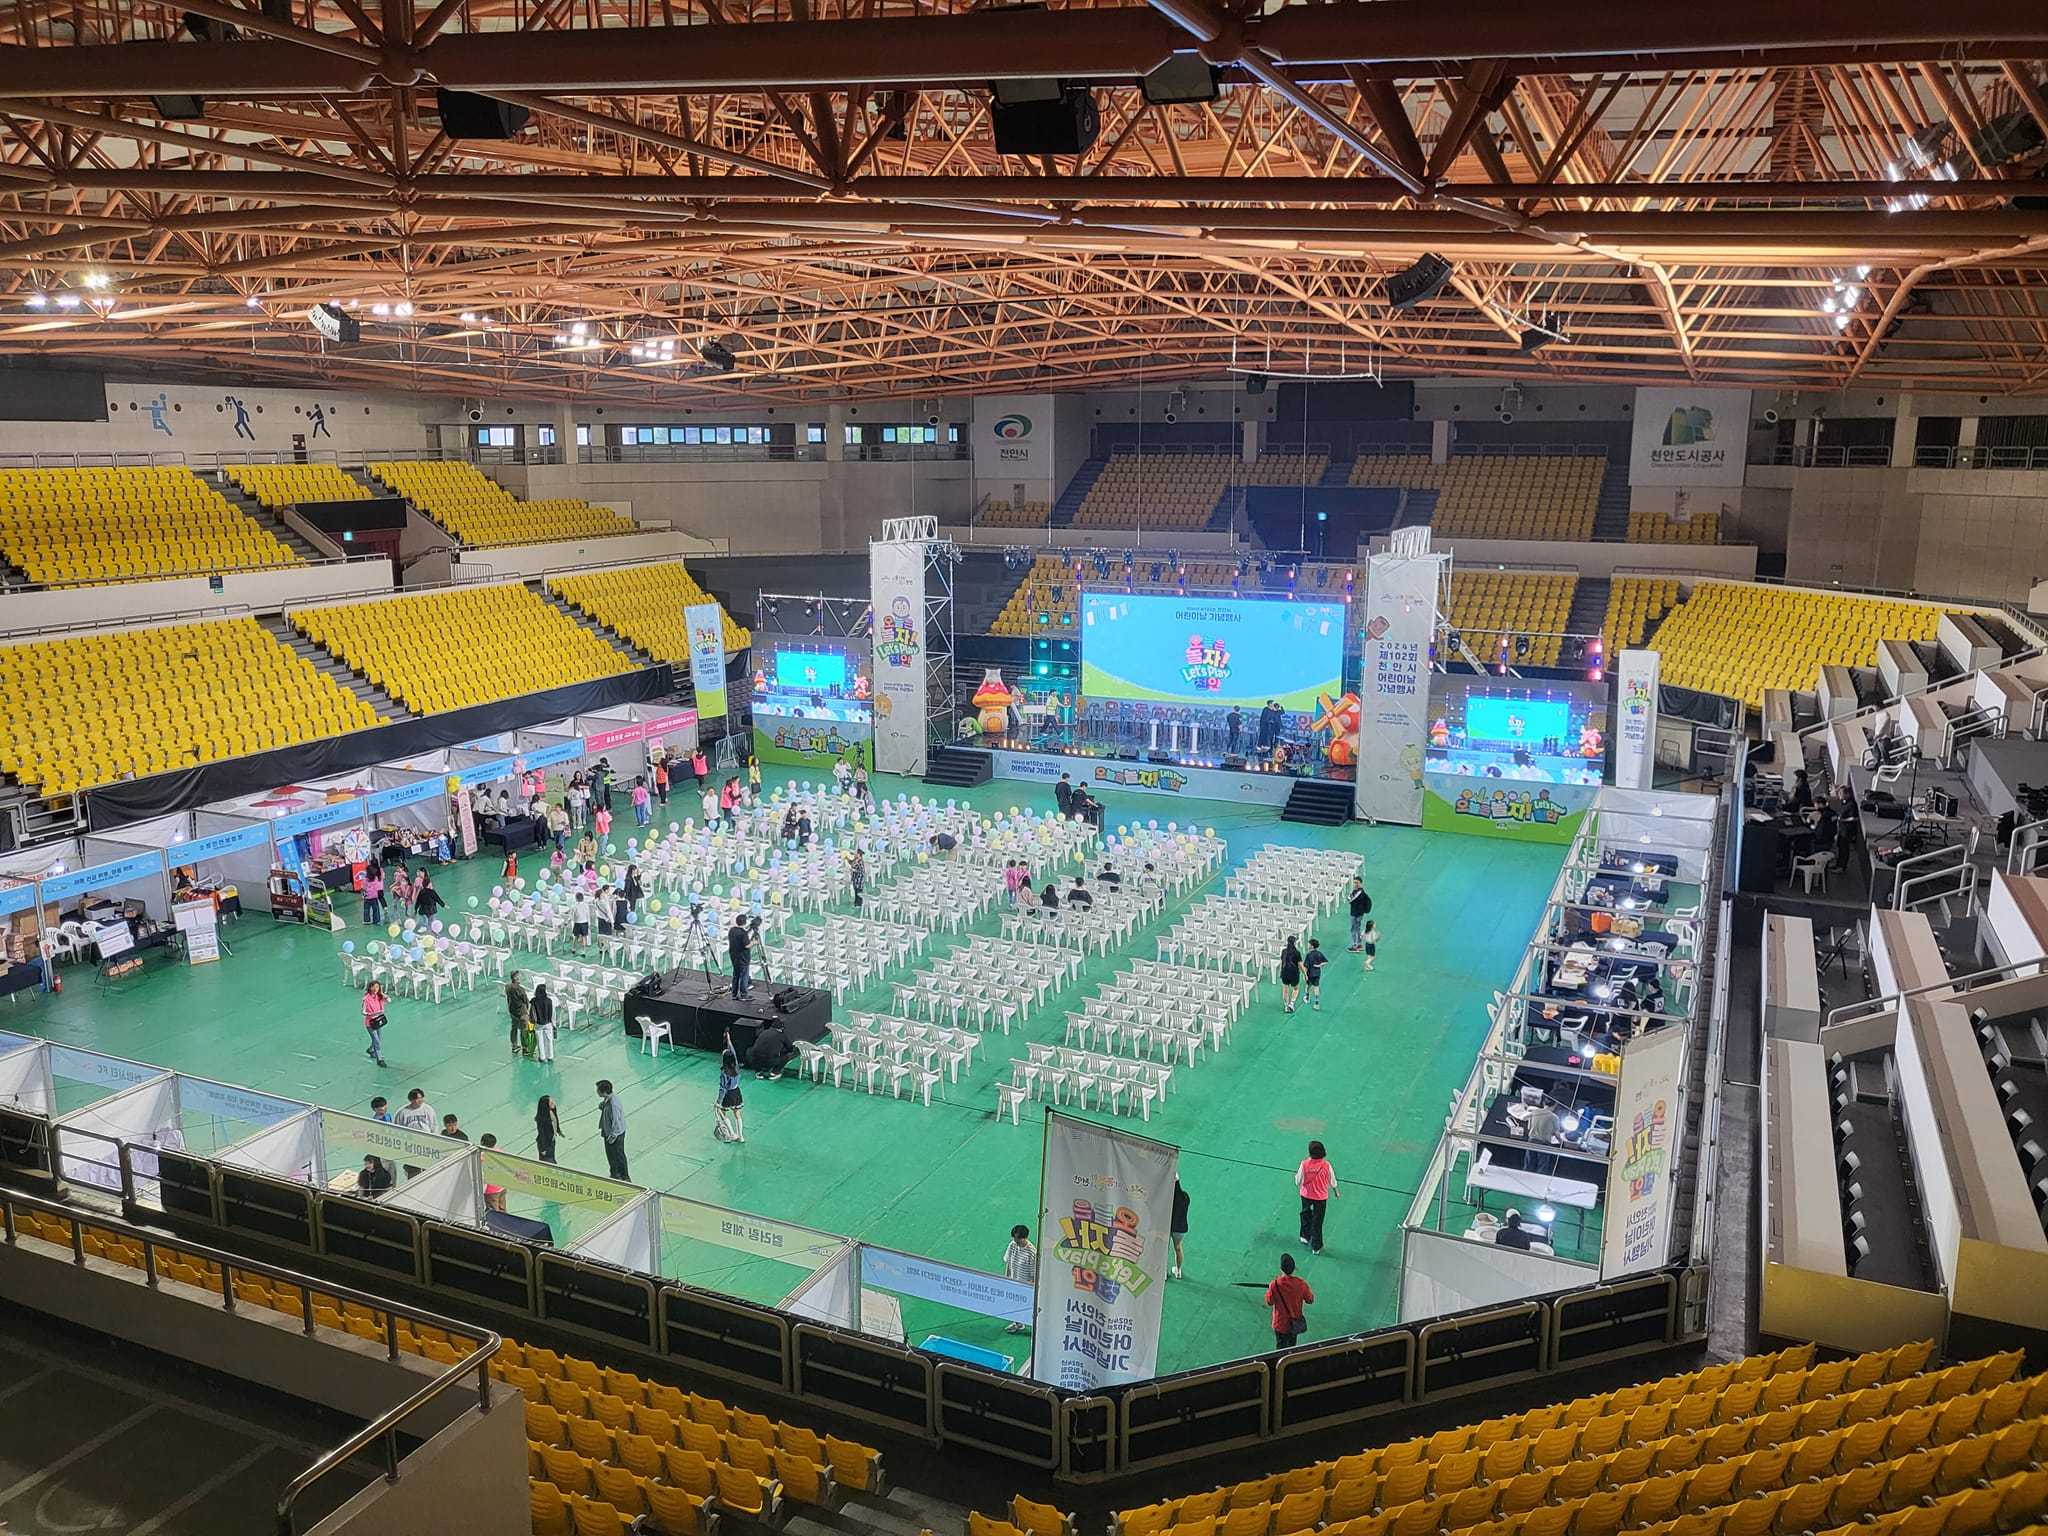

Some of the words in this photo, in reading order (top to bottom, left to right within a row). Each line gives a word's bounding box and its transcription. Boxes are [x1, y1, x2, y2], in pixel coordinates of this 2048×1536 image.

[1000, 449, 1029, 459] 천안시
[1650, 450, 1725, 463] 천안도시공사
[1176, 611, 1207, 621] 어린이날
[1209, 612, 1241, 622] 기념행사
[1379, 642, 1418, 651] 2024년
[1379, 651, 1417, 661] 제102회
[1378, 673, 1416, 684] 어린이날
[1377, 684, 1415, 695] 기념행사
[1011, 765, 1035, 773] 어린이날
[1036, 768, 1060, 776] 기념행사
